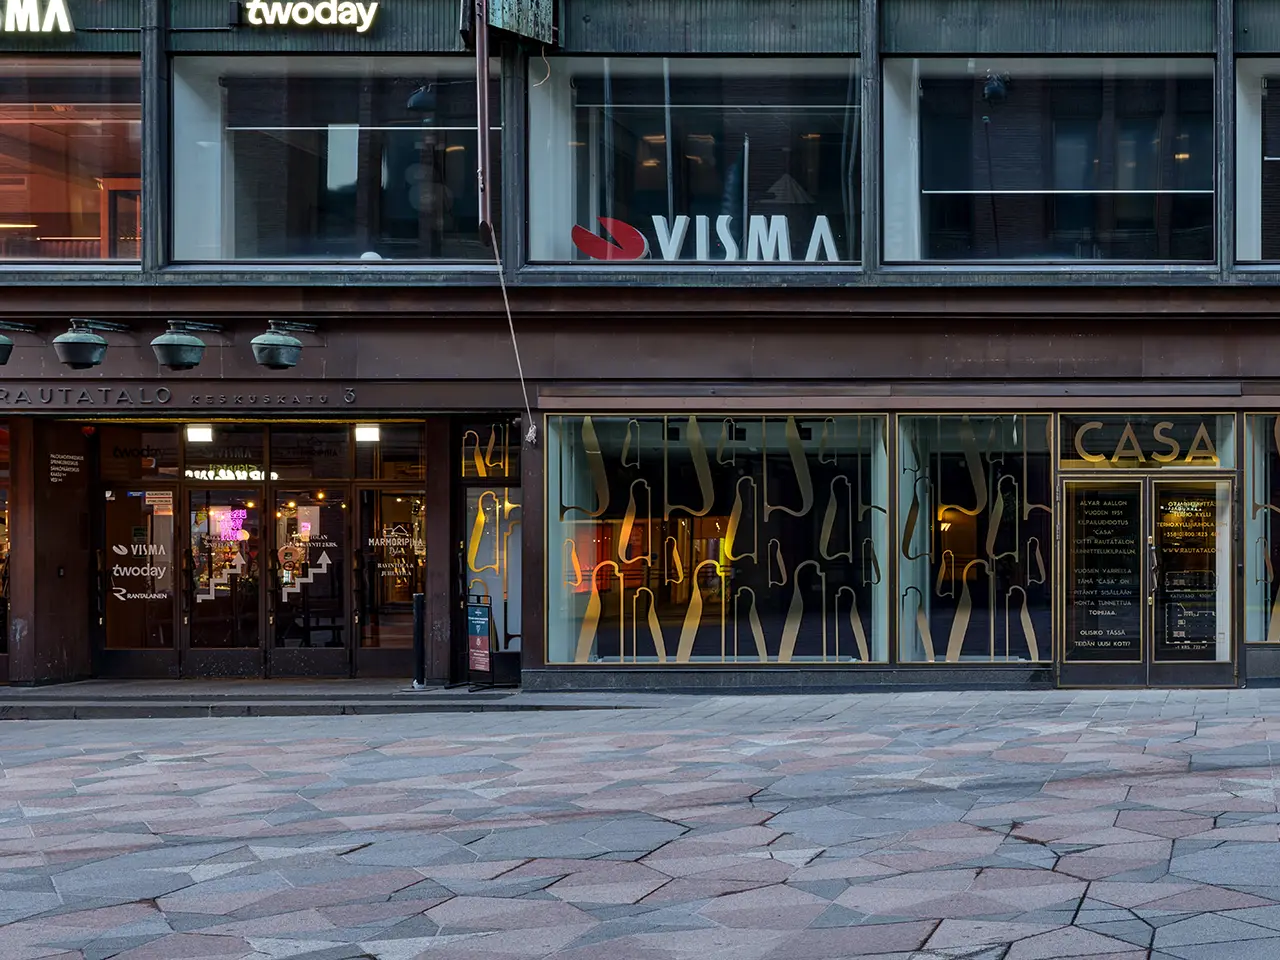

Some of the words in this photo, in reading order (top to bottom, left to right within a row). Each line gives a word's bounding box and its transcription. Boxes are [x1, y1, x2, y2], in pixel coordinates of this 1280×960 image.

[651, 214, 841, 262] VISMA
[190, 394, 329, 404] KESKUSKATU
[343, 387, 357, 404] 3
[1074, 421, 1220, 463] CASA
[130, 544, 166, 556] VISMA
[111, 562, 167, 580] twoday
[126, 592, 168, 600] RANTALAINEN
